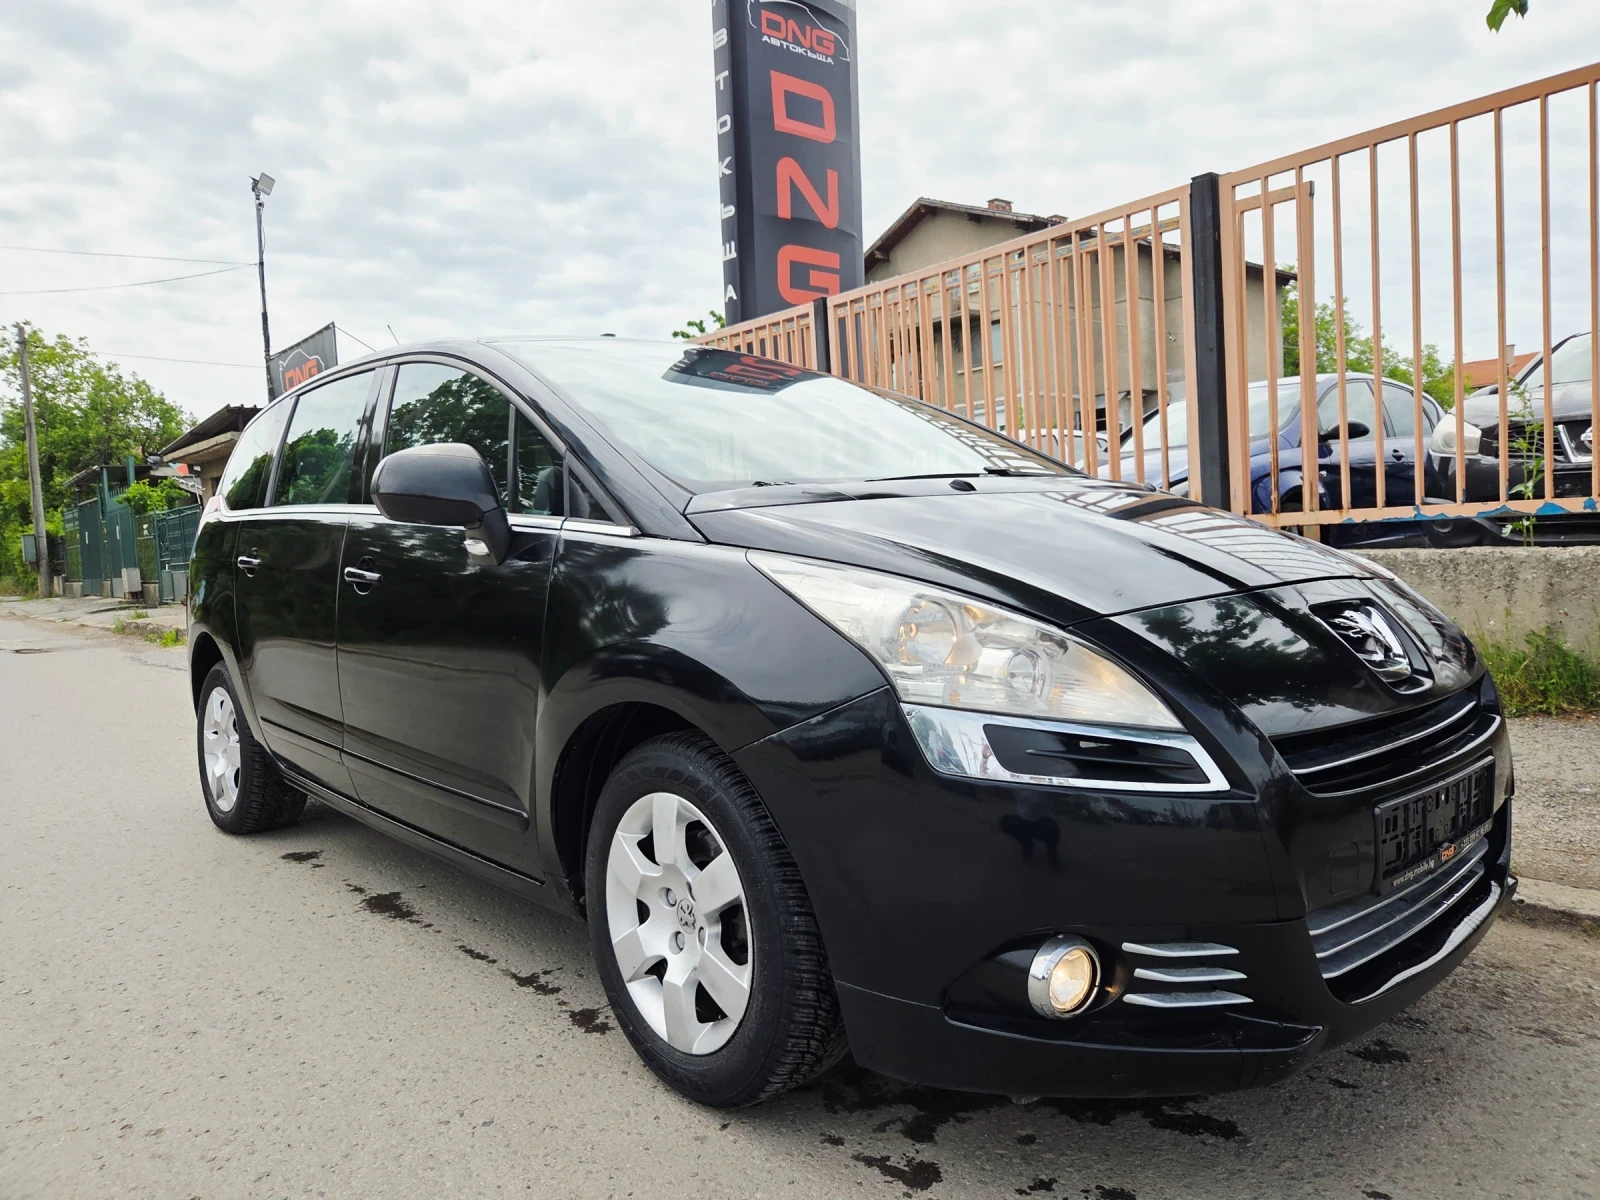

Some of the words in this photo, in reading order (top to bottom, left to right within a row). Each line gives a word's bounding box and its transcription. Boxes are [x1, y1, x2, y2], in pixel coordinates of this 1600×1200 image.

[761, 10, 835, 56] DNG
[761, 35, 834, 65] АВТОКЪЩА
[712, 0, 737, 302] ВТОКЪЩА
[770, 69, 840, 305] DNG
